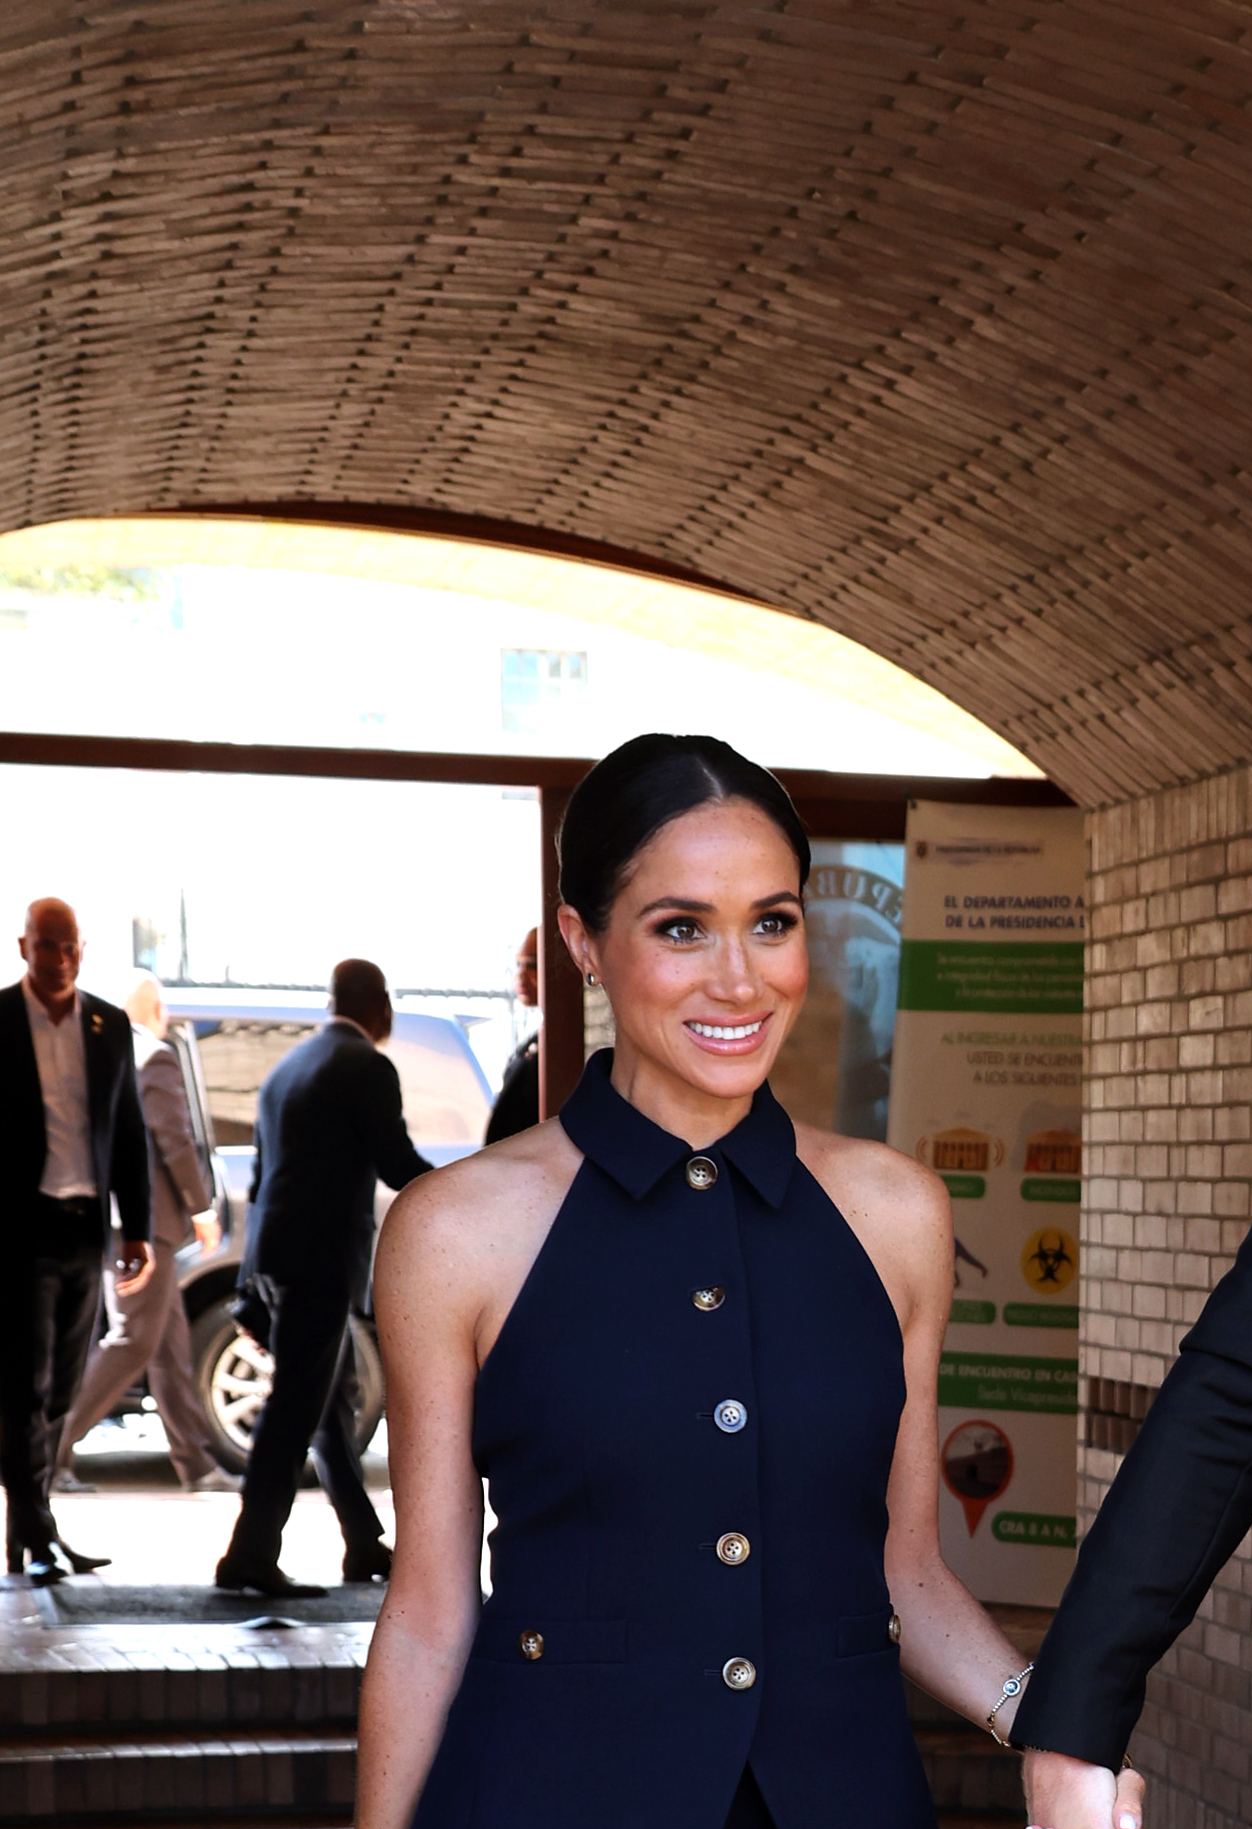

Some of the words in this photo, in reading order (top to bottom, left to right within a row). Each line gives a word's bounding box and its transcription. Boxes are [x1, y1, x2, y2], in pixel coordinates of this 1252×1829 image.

[944, 896, 958, 908] EL
[963, 896, 1070, 909] DEPARTAMENTO
[945, 915, 963, 928] DE
[968, 916, 985, 928] LA
[989, 916, 1075, 929] PRESIDENCIA
[967, 1052, 1004, 1065] USTED
[1011, 1072, 1077, 1086] SIGUIENTES
[958, 1365, 1030, 1380] ENCUENTRO
[998, 1520, 1025, 1534] CRA
[1040, 1523, 1050, 1535] A
